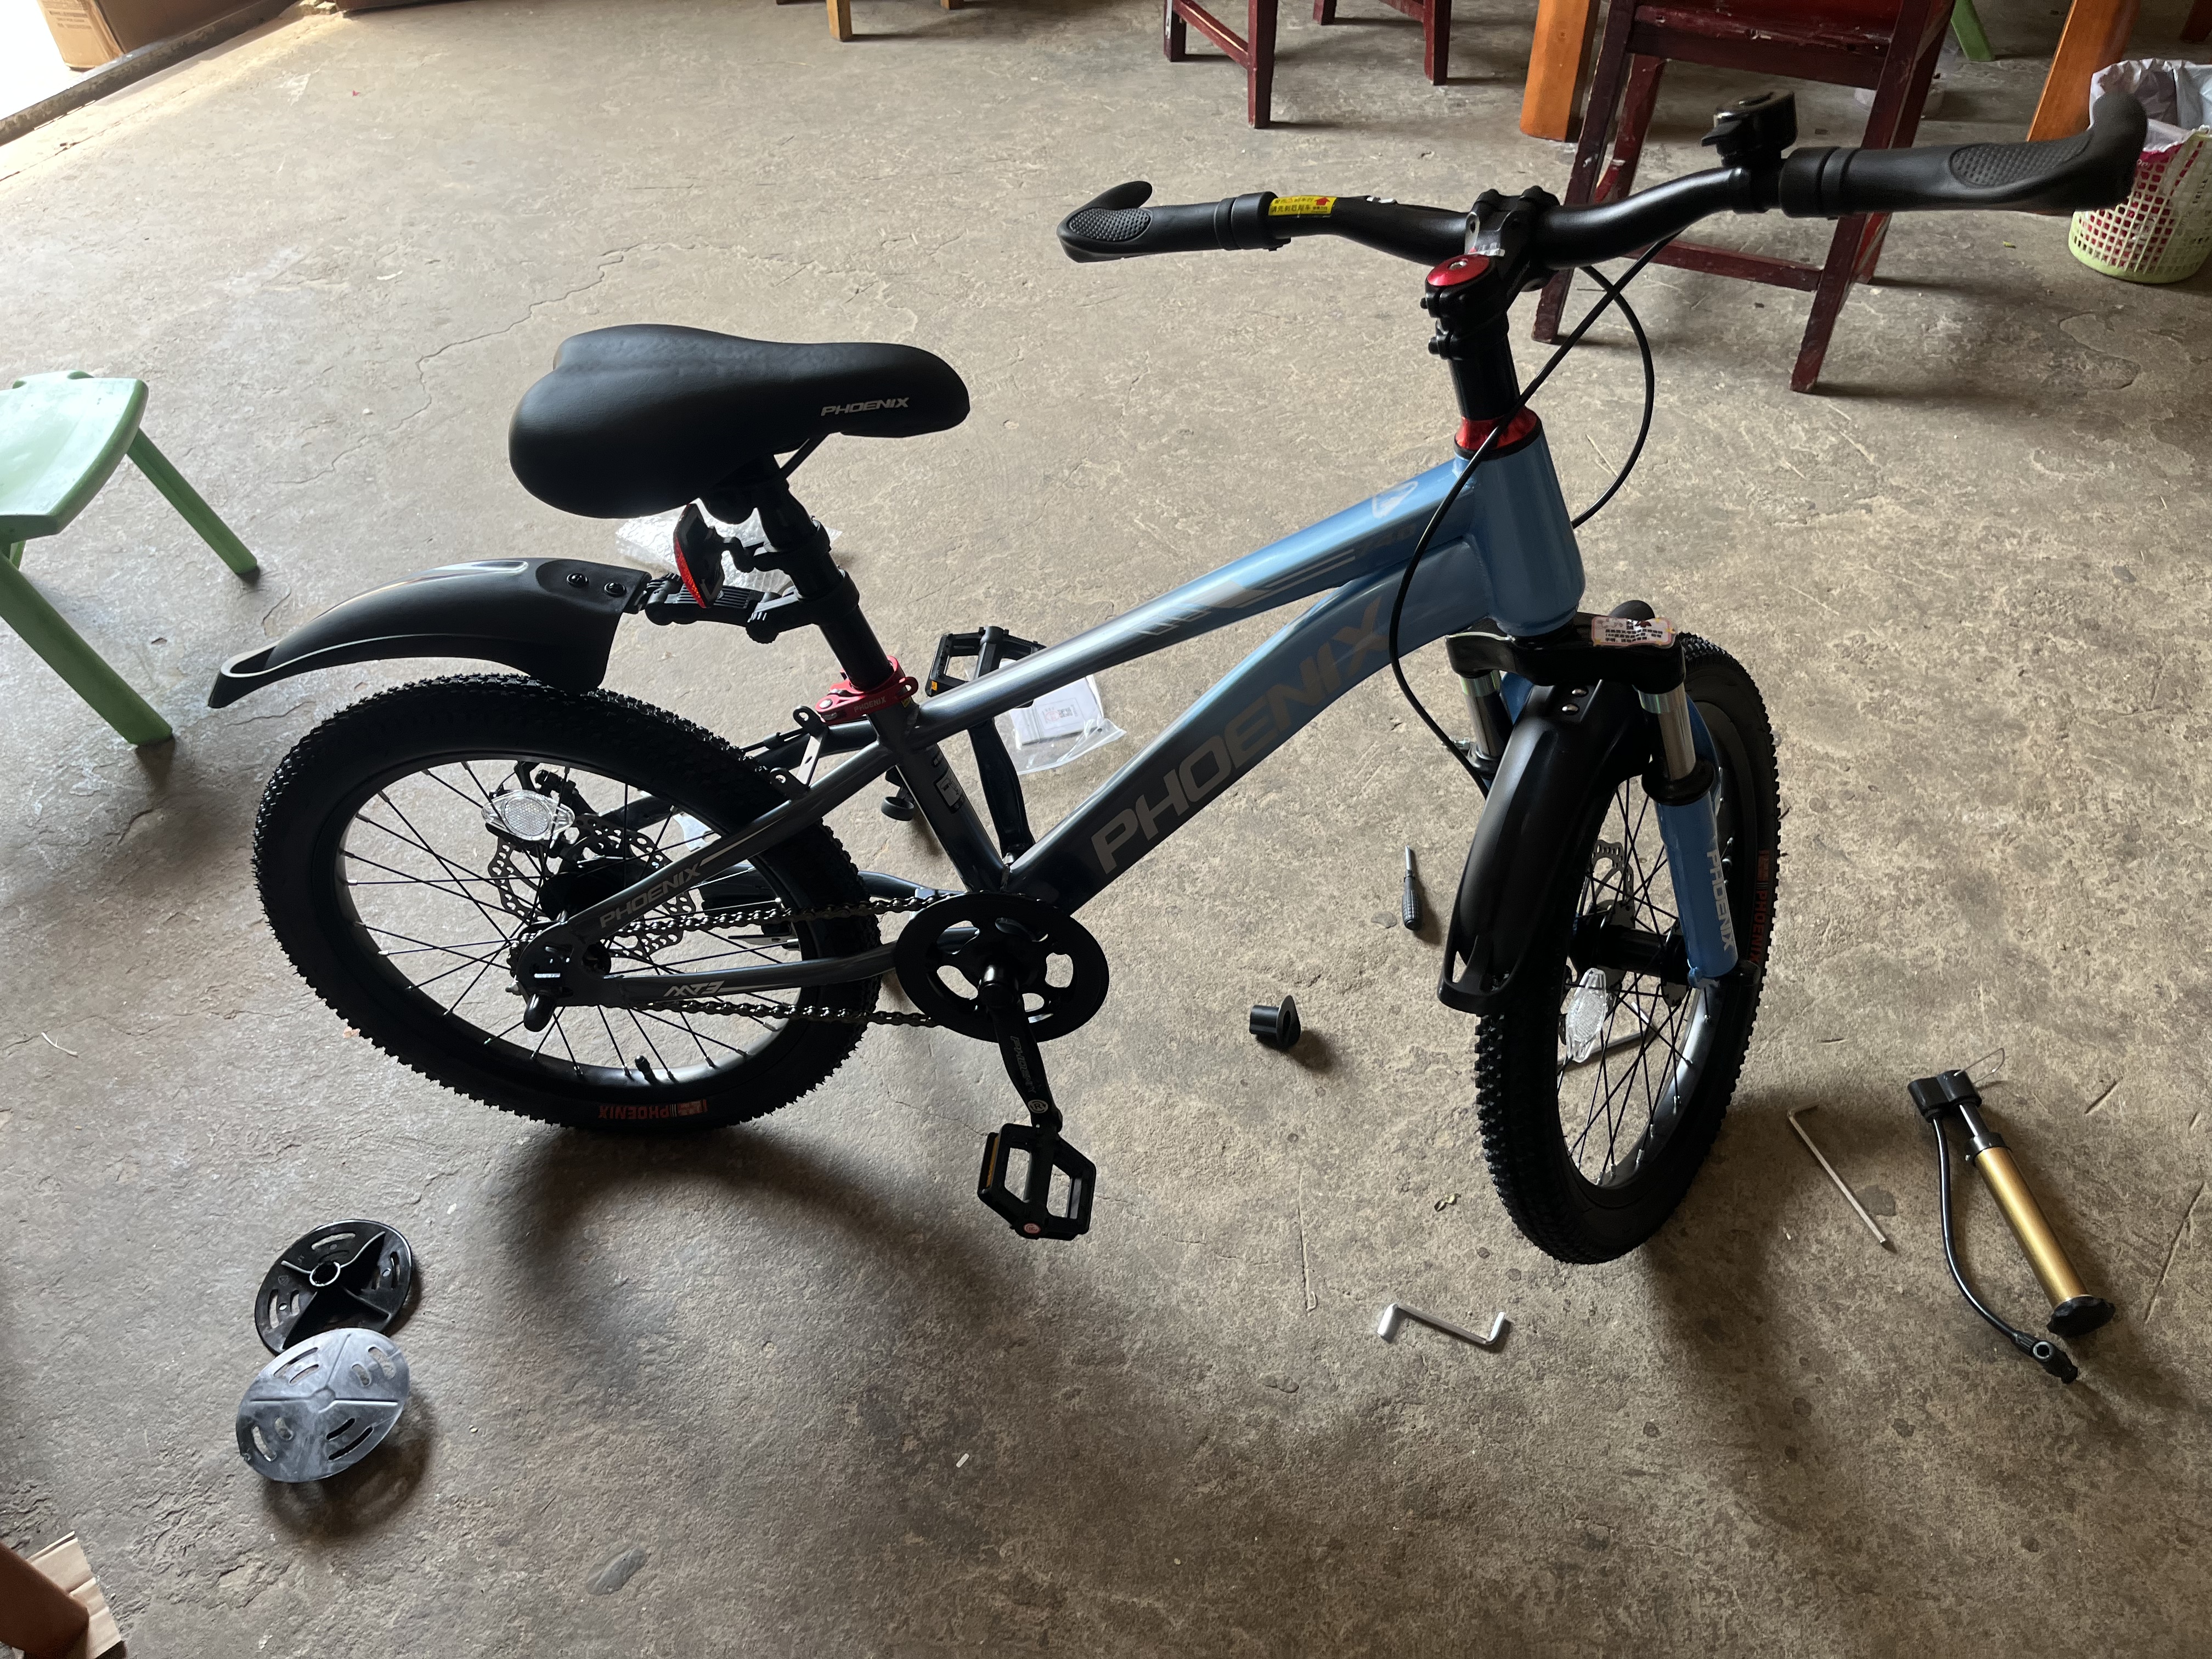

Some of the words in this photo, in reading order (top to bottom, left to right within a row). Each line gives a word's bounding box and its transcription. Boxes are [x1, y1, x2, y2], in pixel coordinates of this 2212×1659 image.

[821, 397, 909, 416] PHOENIX
[854, 696, 887, 713] PHOENIX
[1091, 596, 1389, 874] PHOENIX
[600, 862, 701, 929] PHOENIX
[1707, 849, 1735, 952] PHOENIX
[1750, 890, 1768, 963] PHOENIX
[598, 1104, 670, 1120] PHOENIX
